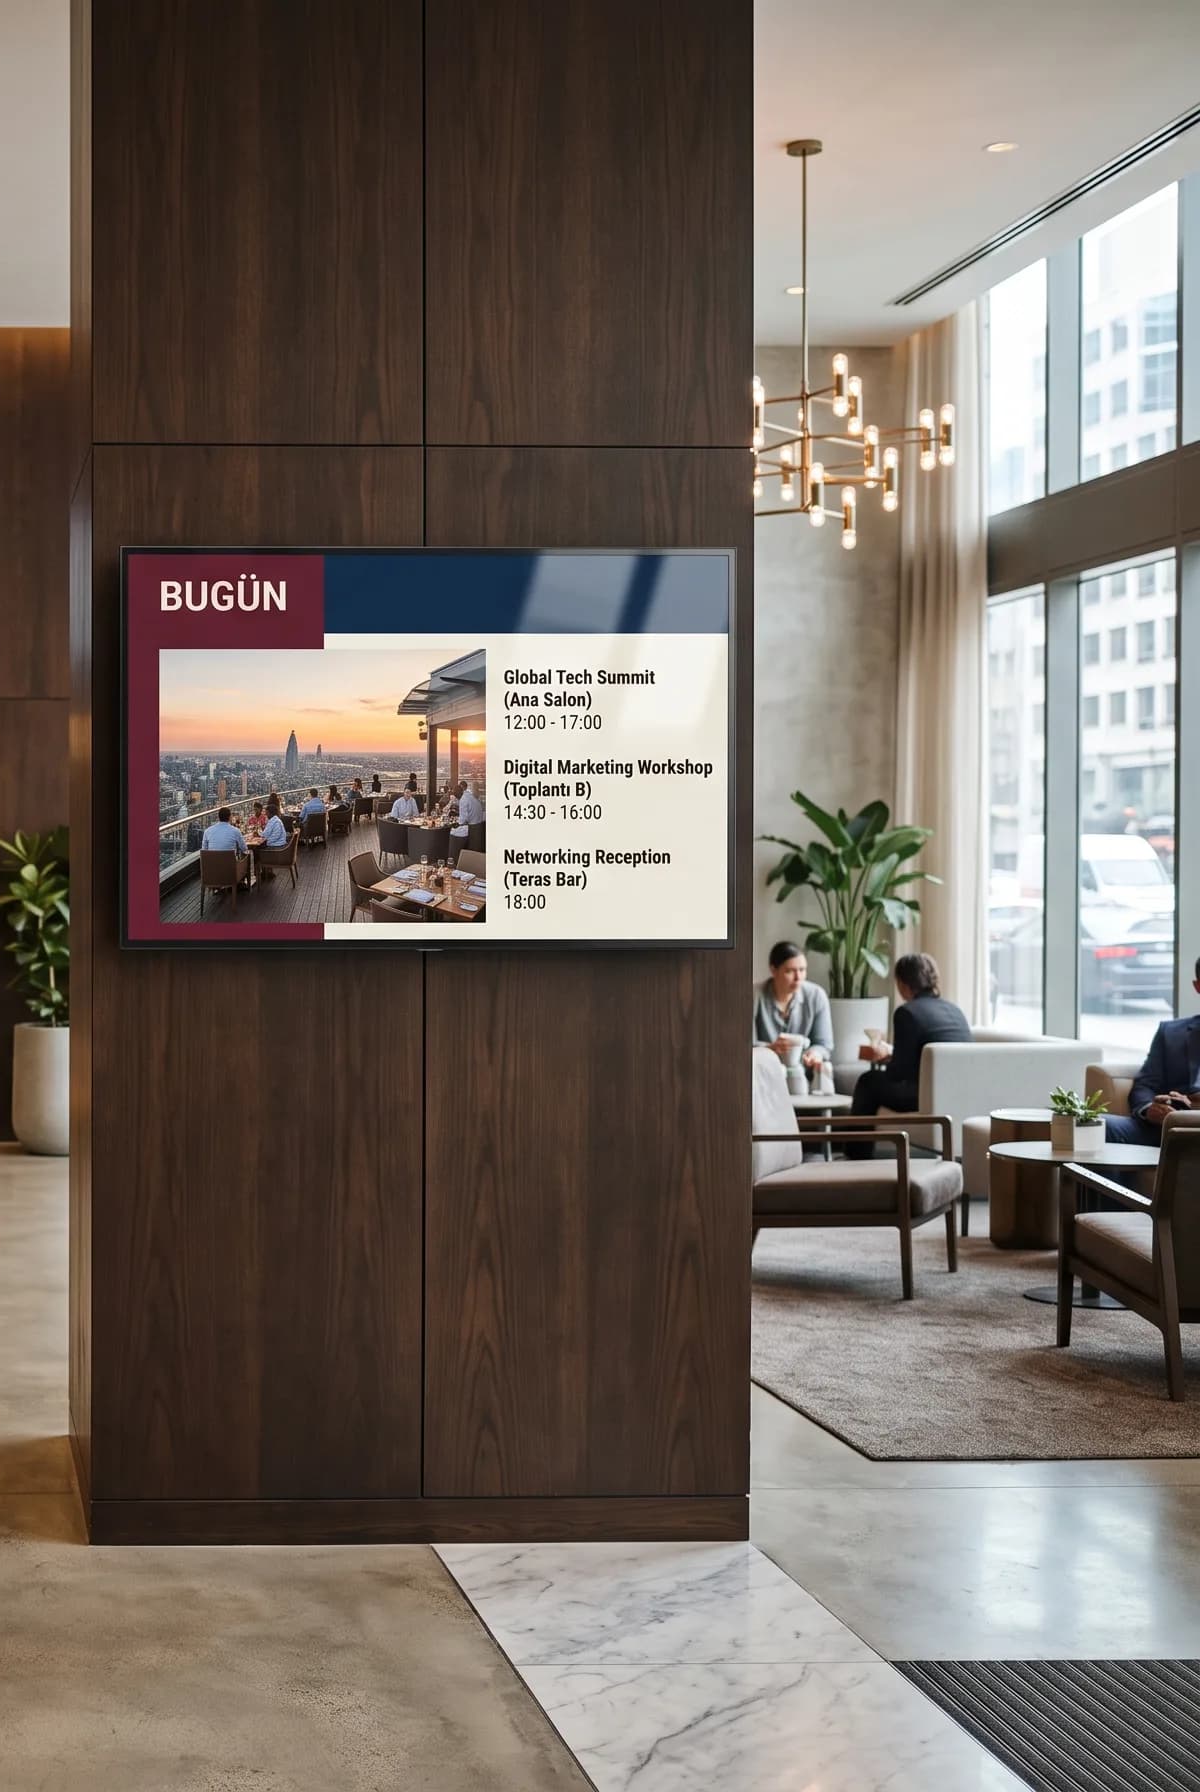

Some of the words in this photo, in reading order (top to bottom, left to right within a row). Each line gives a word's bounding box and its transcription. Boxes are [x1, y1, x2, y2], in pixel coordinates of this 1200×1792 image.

[160, 573, 288, 612] BUGÜN
[503, 669, 552, 685] Global
[555, 669, 593, 685] Tech
[596, 669, 656, 685] Summit
[503, 691, 539, 711] (Ana
[543, 691, 592, 711] Salon)
[504, 714, 546, 730] 12:00
[559, 714, 602, 730] 17:00
[503, 758, 553, 779] Digital
[557, 758, 634, 779] Marketing
[637, 758, 713, 779] Workshop
[503, 781, 571, 801] (Toplantı
[575, 781, 592, 801] B)
[504, 804, 546, 820] 14:30
[560, 804, 602, 820] 16:00
[503, 848, 591, 868] Networking
[595, 848, 671, 869] Reception
[503, 870, 552, 891] (Teras
[555, 870, 588, 891] Bar)
[504, 893, 546, 910] 18:00
